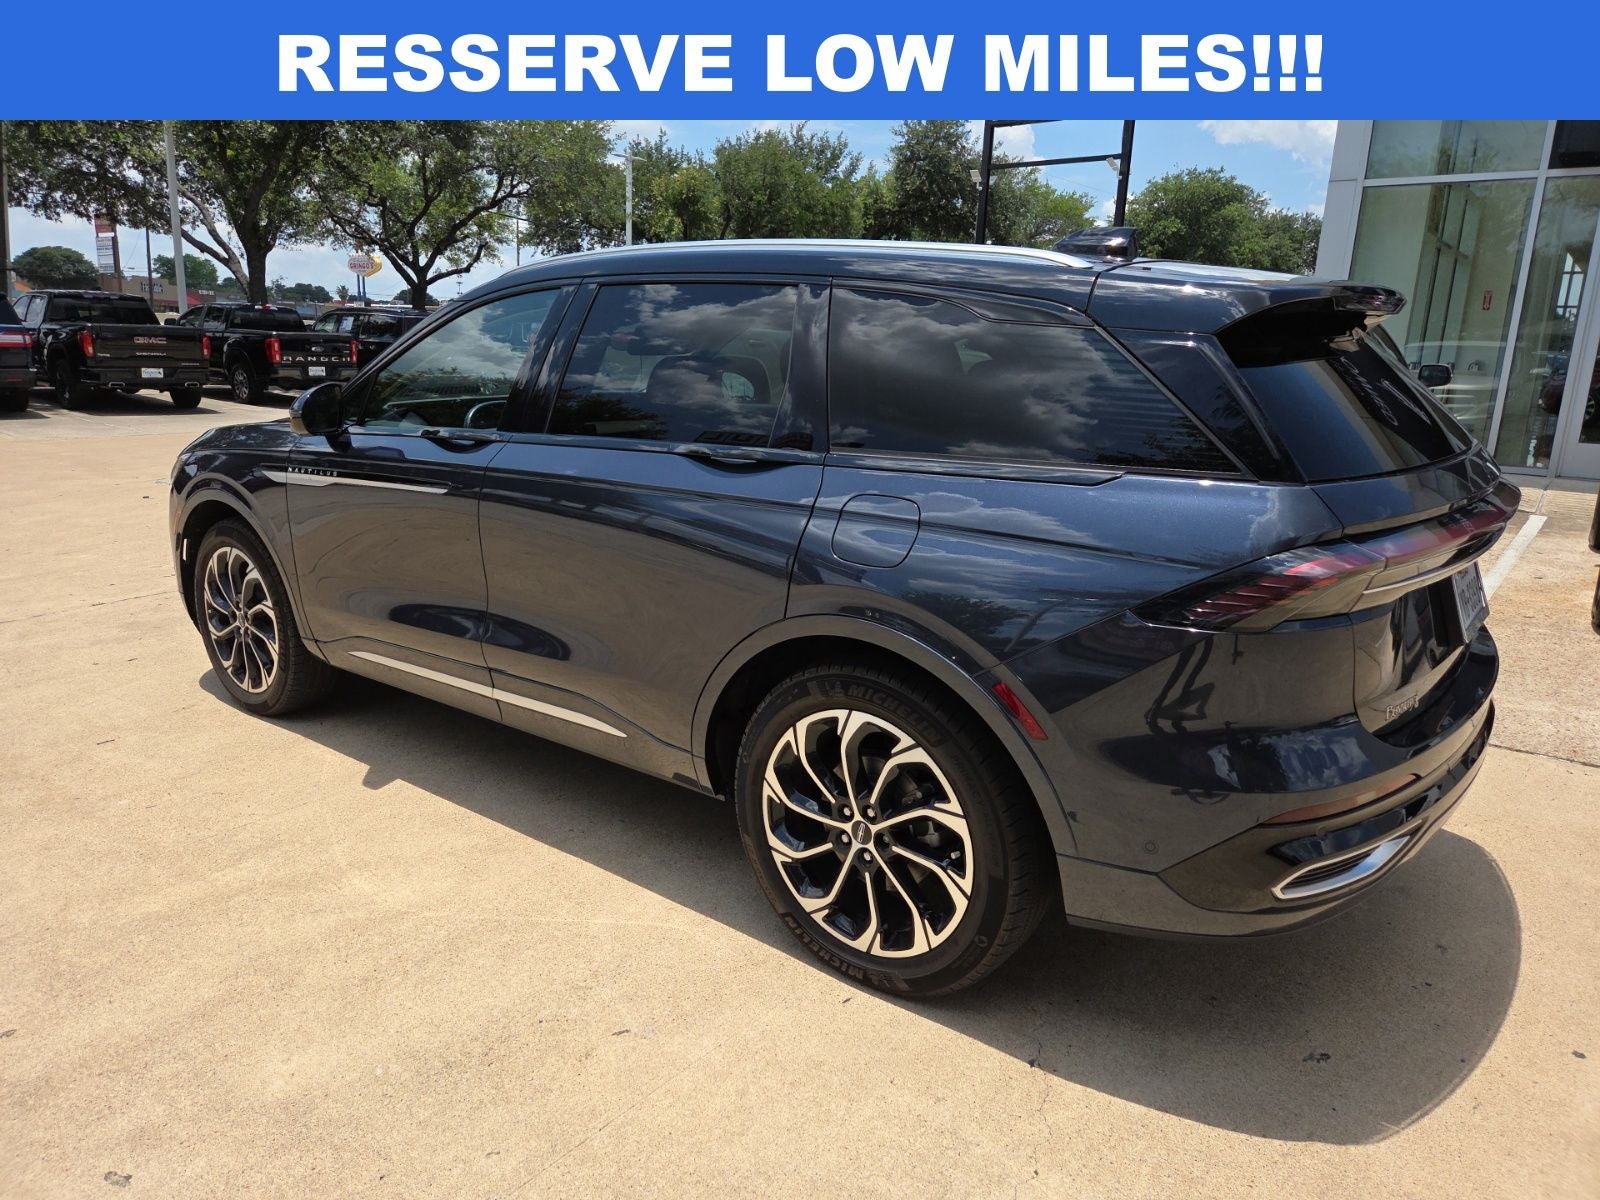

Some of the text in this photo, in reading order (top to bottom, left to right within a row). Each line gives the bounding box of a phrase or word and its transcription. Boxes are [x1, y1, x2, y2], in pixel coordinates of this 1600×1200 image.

[133, 336, 167, 344] GMC
[287, 466, 338, 477] NAUTILUS
[847, 684, 945, 747] MICHELIN
[782, 914, 866, 980] MICHELIN
